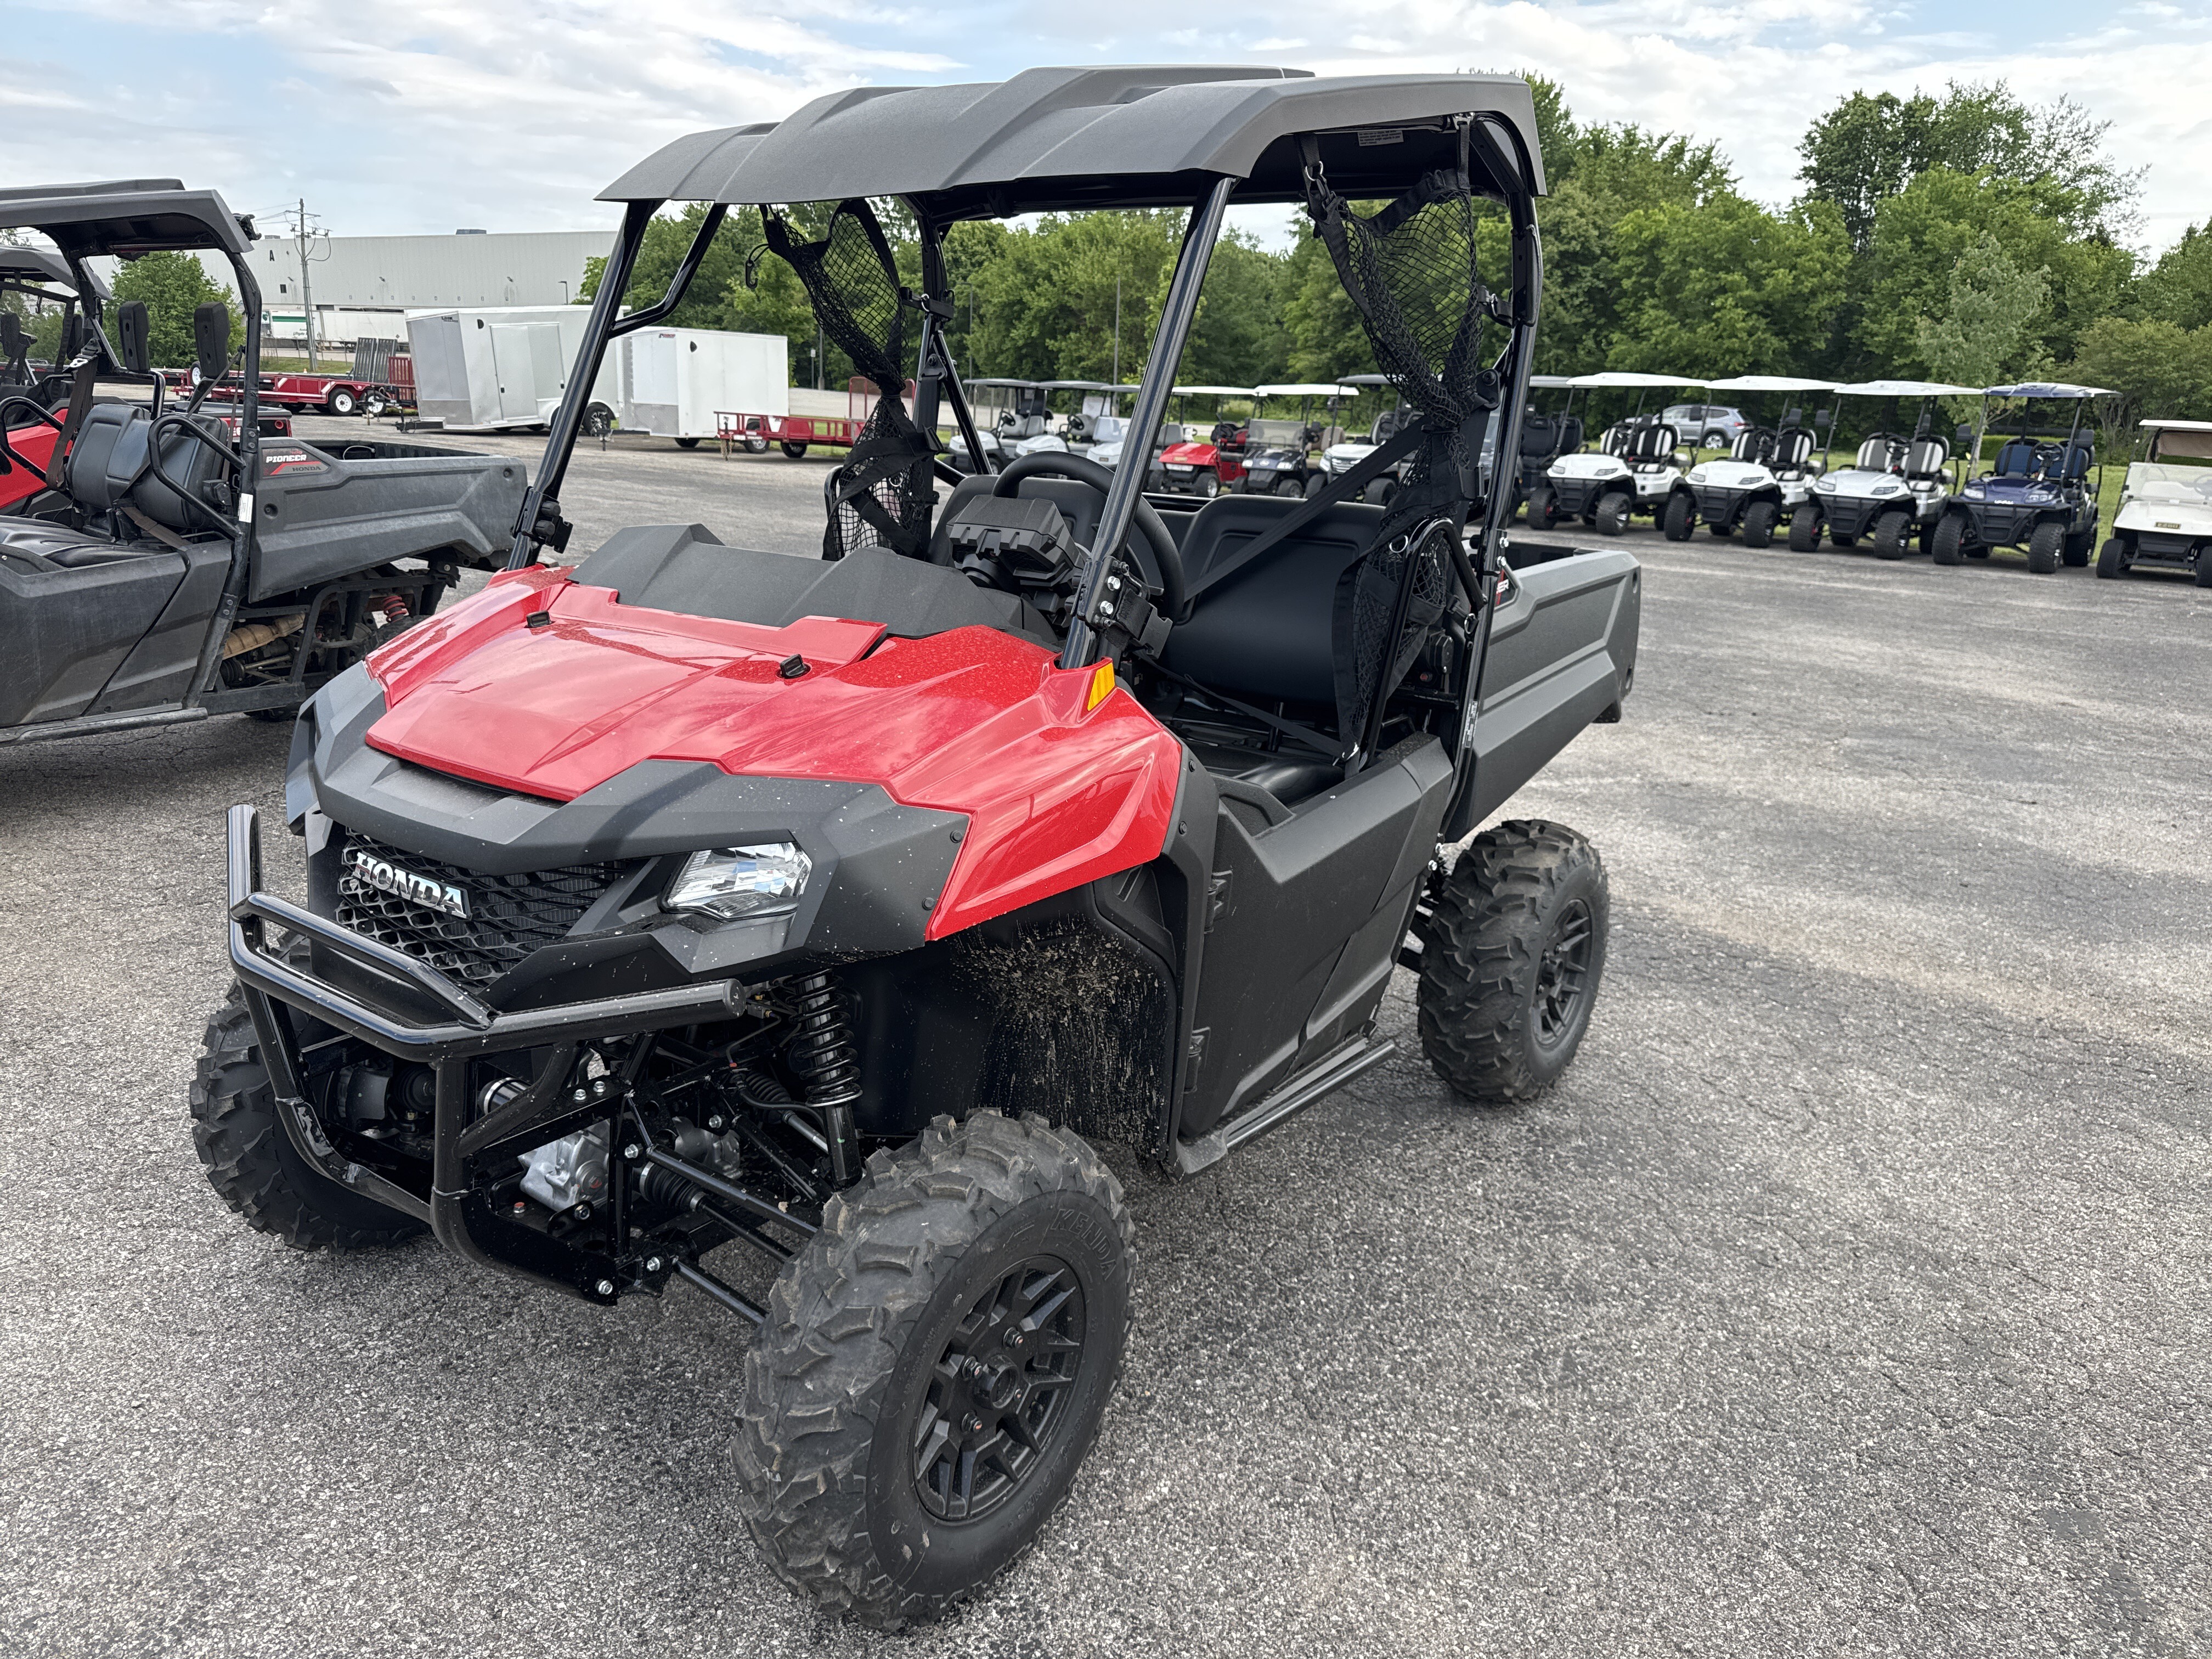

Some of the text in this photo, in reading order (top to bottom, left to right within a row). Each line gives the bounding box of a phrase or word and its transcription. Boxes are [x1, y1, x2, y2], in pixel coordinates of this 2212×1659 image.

[269, 250, 275, 262] A
[266, 454, 307, 463] PIONEER
[352, 851, 467, 919] HONDA
[1049, 1209, 1117, 1282] KENDA
